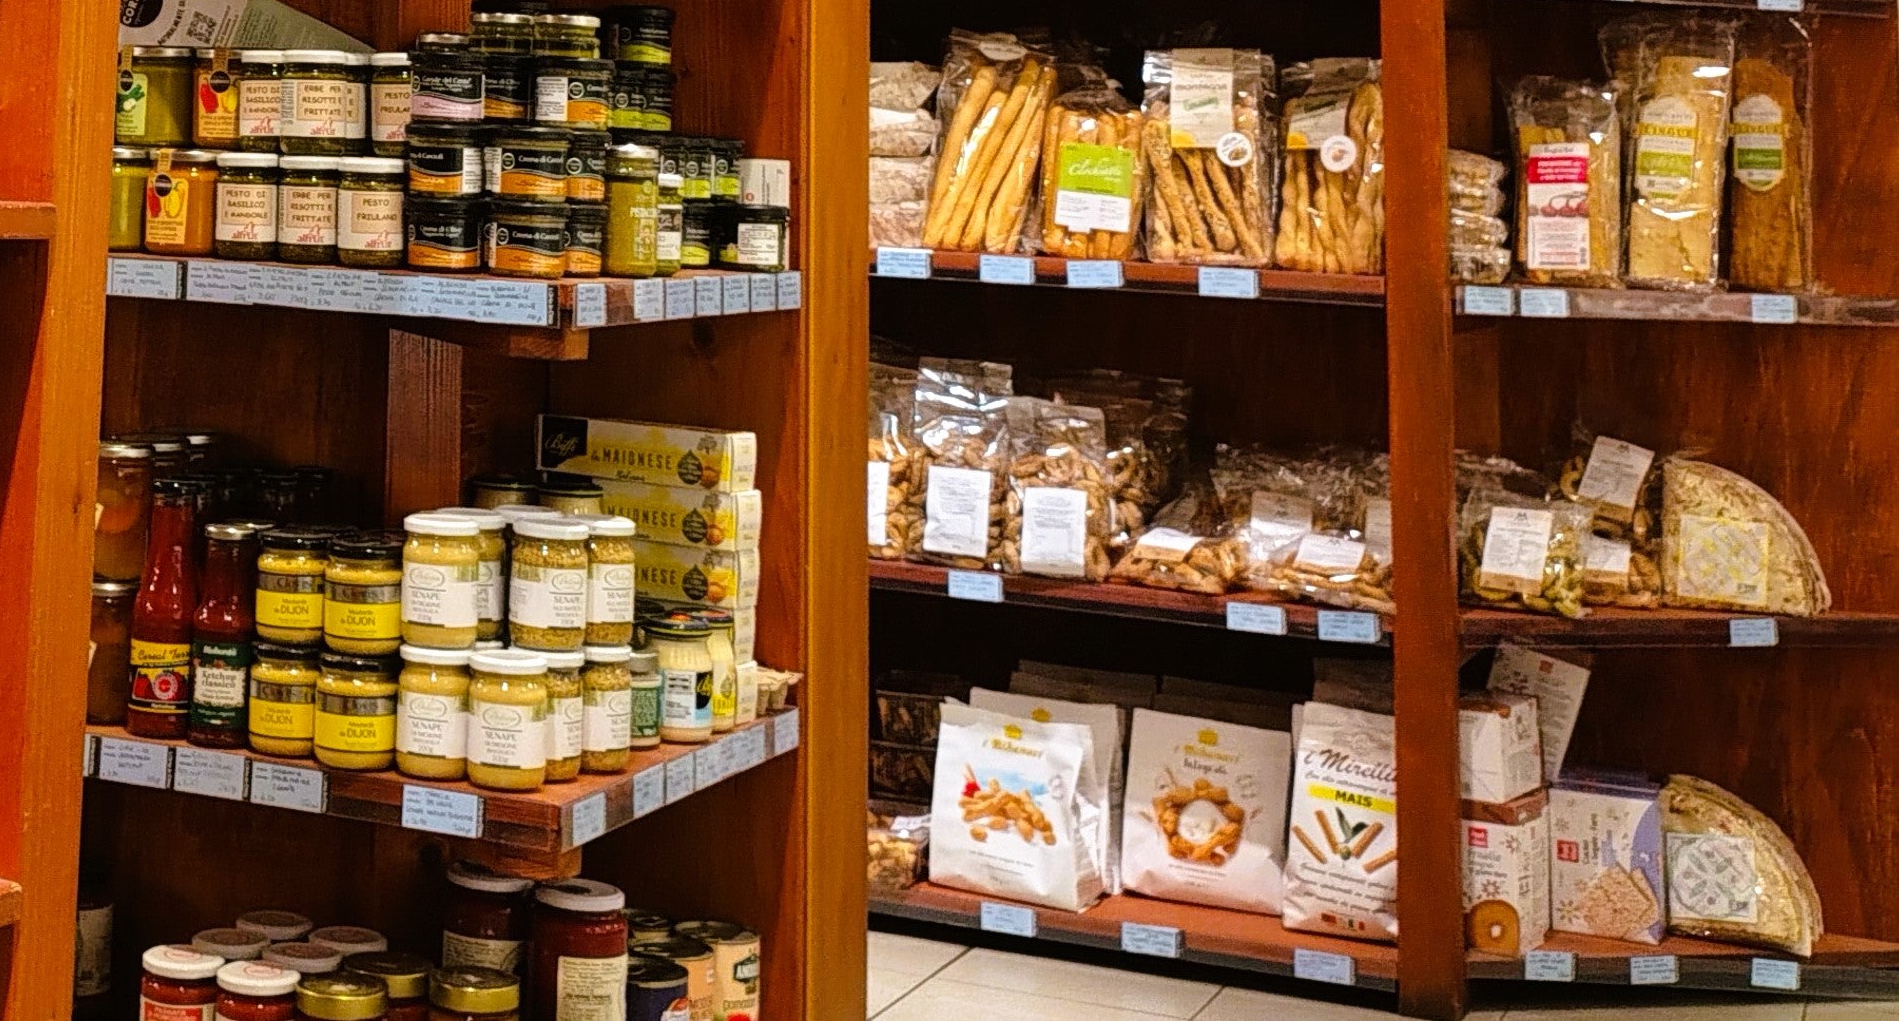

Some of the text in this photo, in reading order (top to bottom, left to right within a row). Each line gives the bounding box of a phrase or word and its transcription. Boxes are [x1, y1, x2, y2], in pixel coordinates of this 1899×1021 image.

[603, 447, 672, 470] MAIONESE
[281, 605, 309, 615] DIJON
[347, 616, 376, 626] DIJON
[265, 714, 293, 724] DIJON
[347, 729, 376, 739] DIJON
[1335, 791, 1374, 808] MAIS
